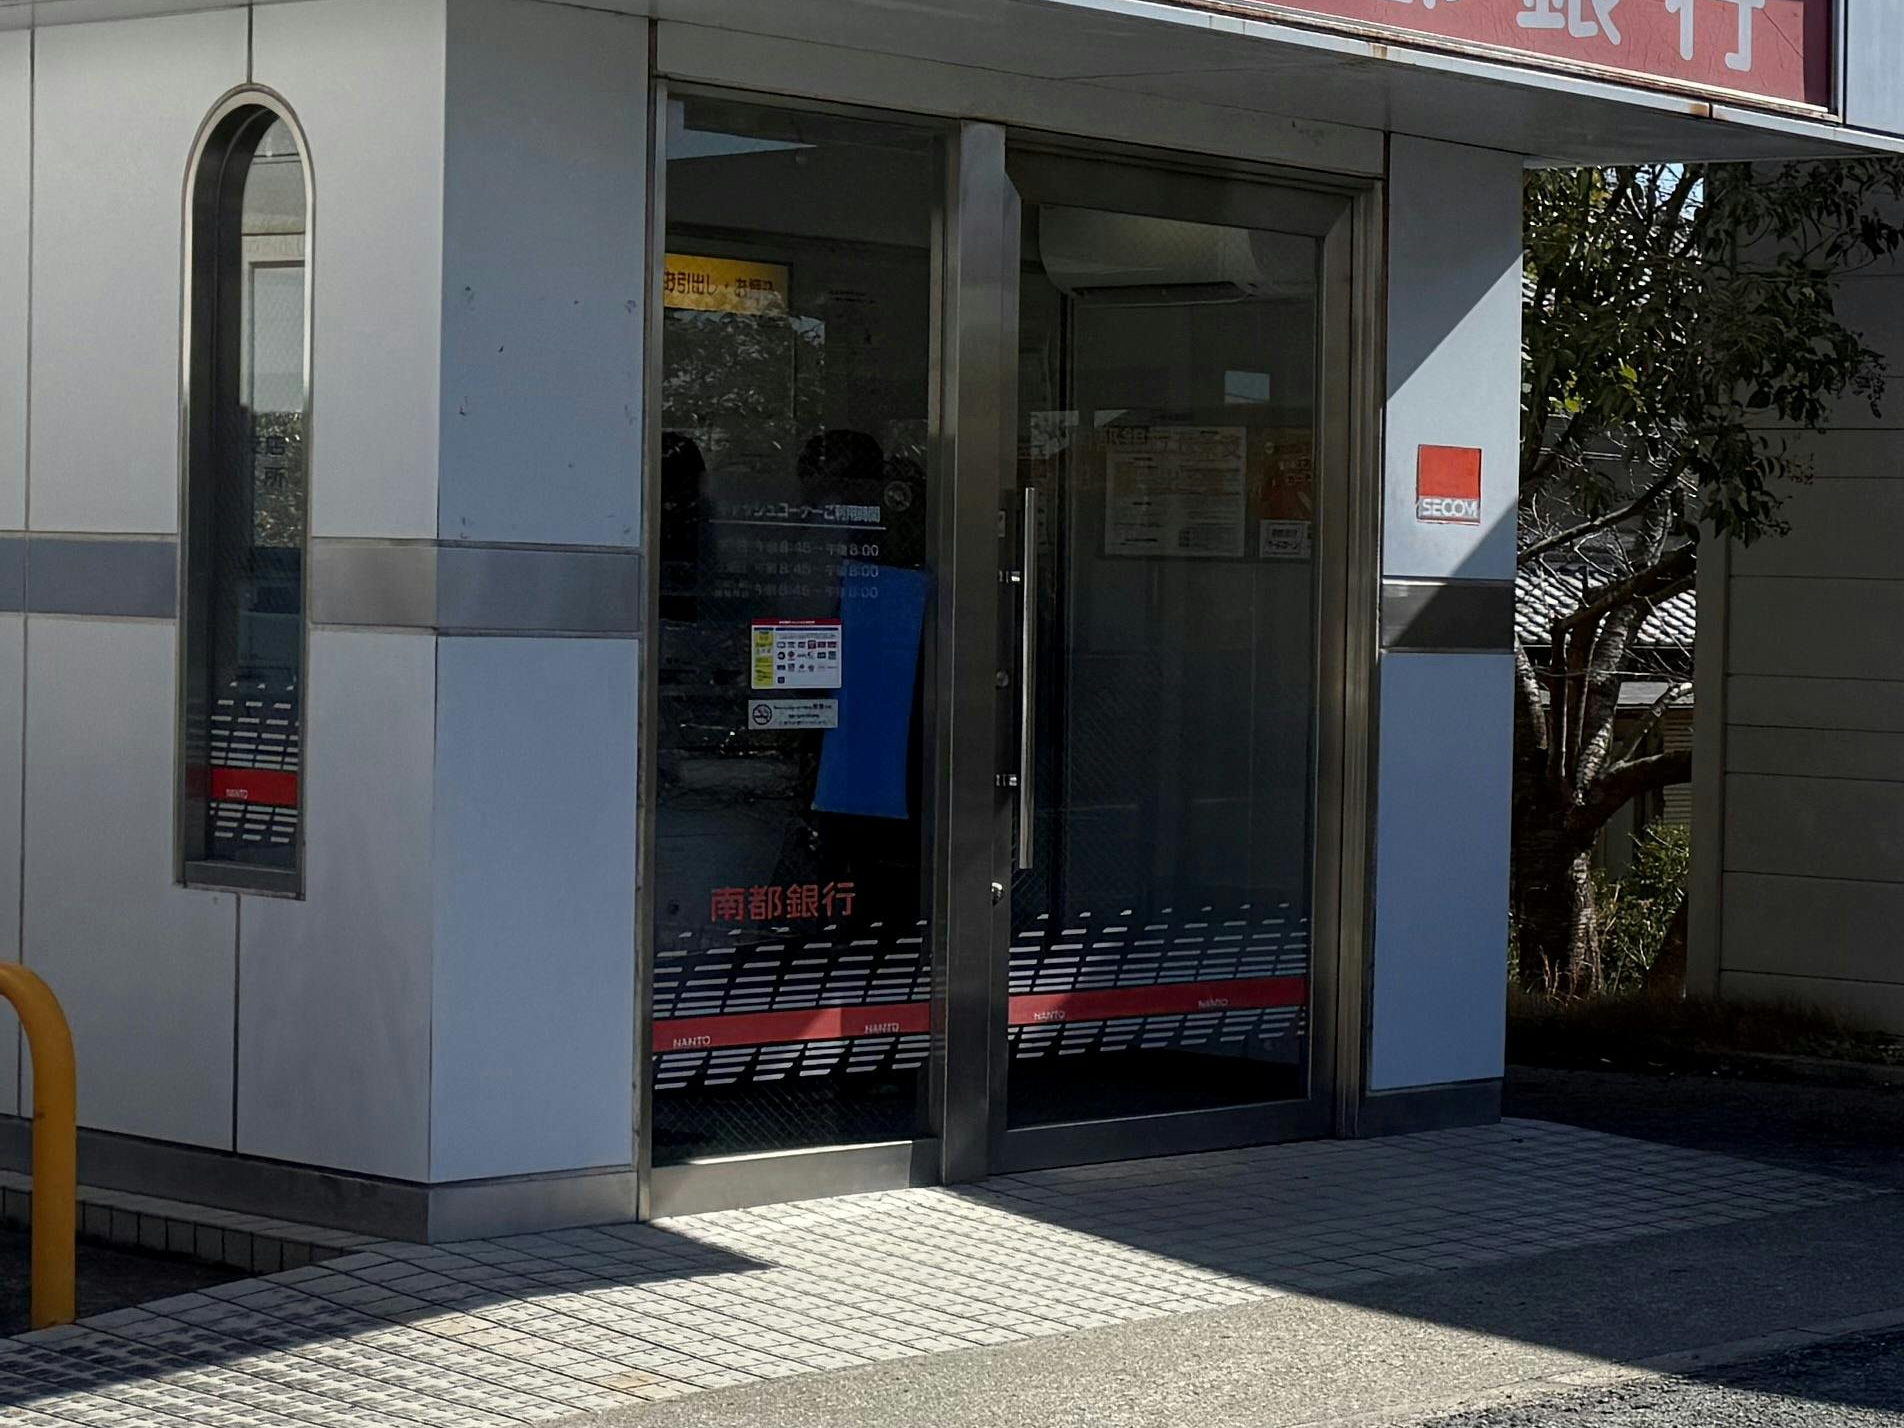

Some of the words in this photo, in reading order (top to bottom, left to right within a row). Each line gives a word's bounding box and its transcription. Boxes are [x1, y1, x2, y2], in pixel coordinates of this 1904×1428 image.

[1422, 498, 1478, 518] SECOM
[710, 881, 856, 924] 南都銀行
